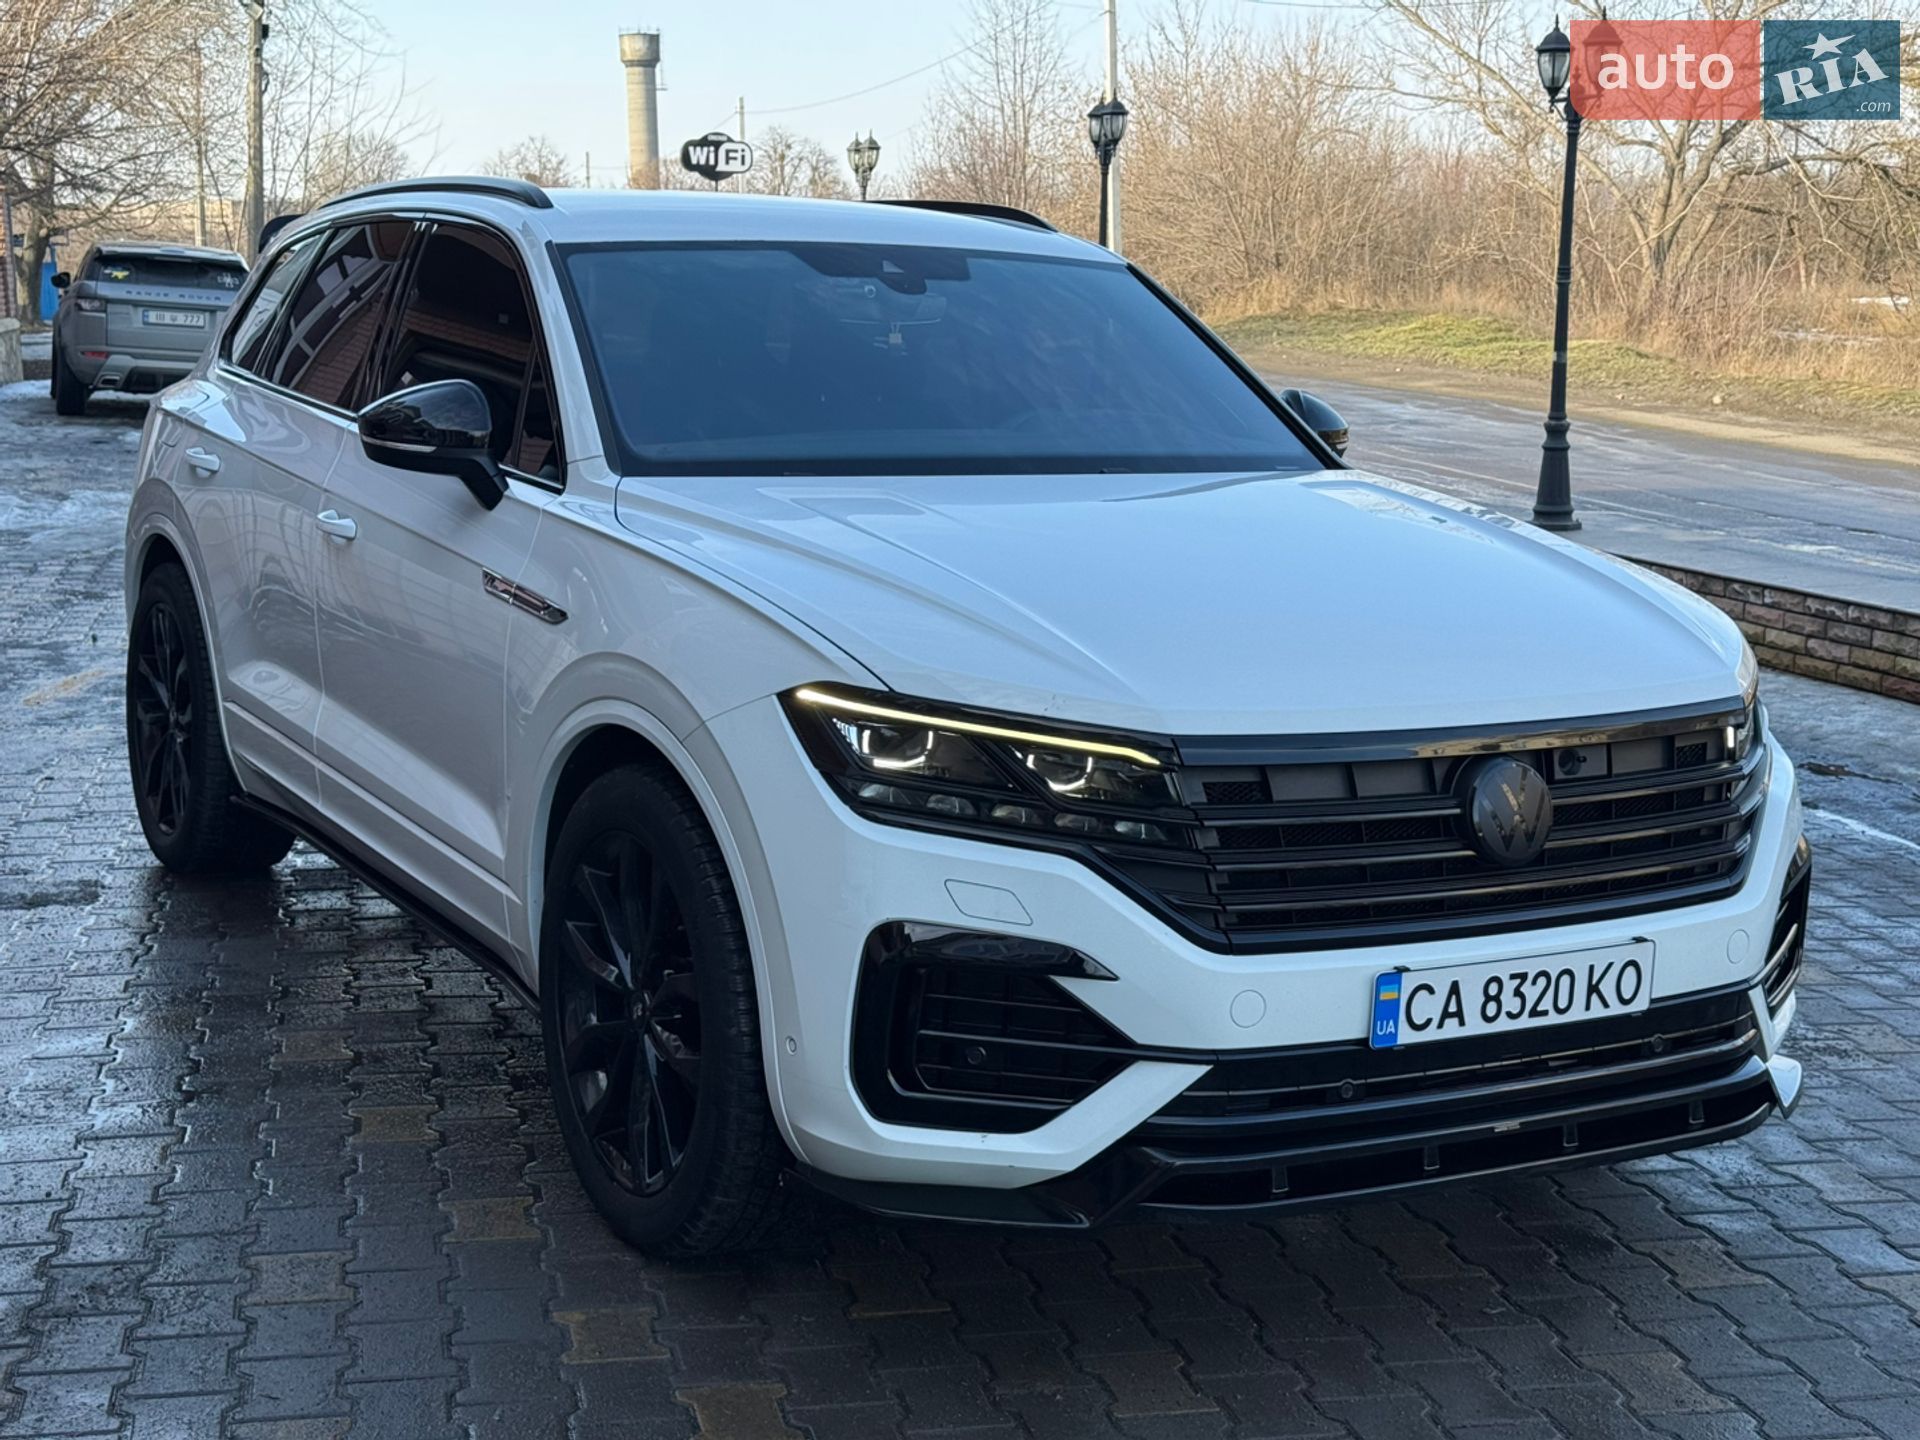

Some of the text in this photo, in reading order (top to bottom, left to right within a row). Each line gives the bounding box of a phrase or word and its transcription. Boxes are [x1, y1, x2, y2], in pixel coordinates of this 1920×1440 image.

[1405, 958, 1642, 1032] CA 8320 KO
[1376, 1020, 1395, 1036] UA
